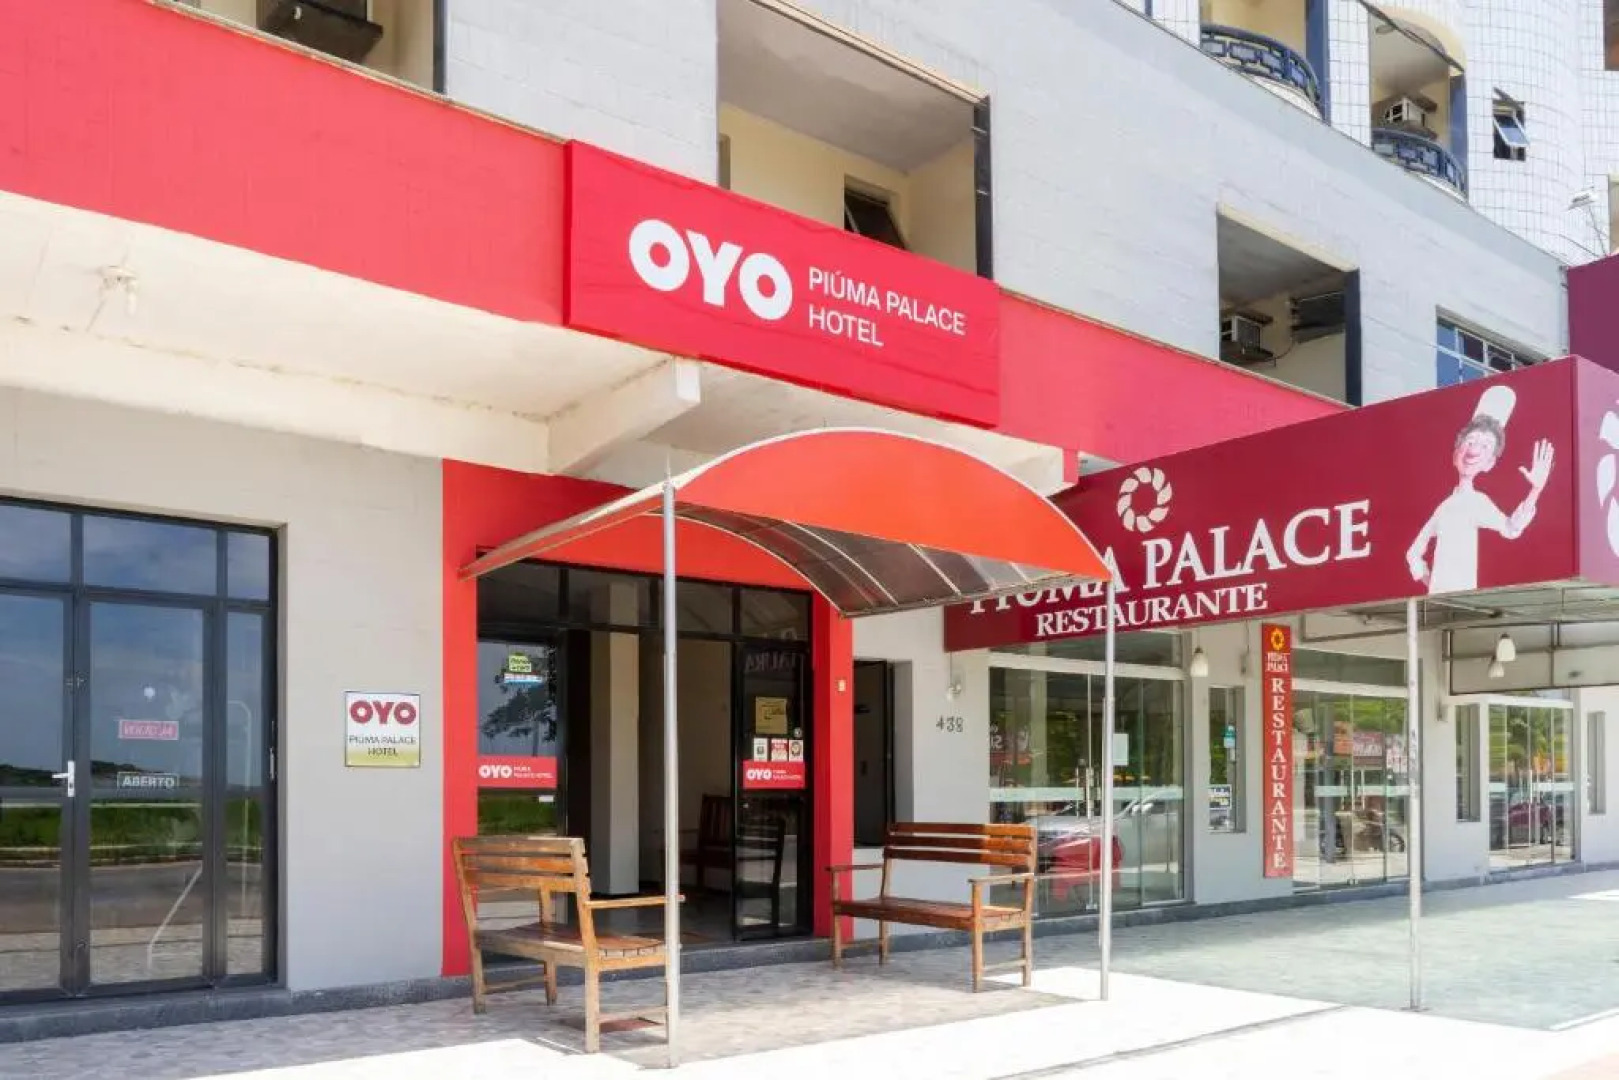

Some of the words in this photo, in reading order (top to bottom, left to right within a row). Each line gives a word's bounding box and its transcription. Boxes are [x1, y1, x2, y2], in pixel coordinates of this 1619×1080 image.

[628, 218, 793, 321] OYO
[808, 266, 881, 310] PIÚMA
[885, 291, 966, 336] PALACE
[808, 304, 884, 347] HOTEL
[1142, 499, 1372, 590] PALACE
[1035, 582, 1269, 637] RESTAURANTE
[350, 700, 417, 725] OYO
[122, 775, 175, 789] ABERTO
[479, 764, 512, 779] OYO
[746, 770, 772, 781] OYO
[1270, 677, 1287, 869] RESTAURANTE
